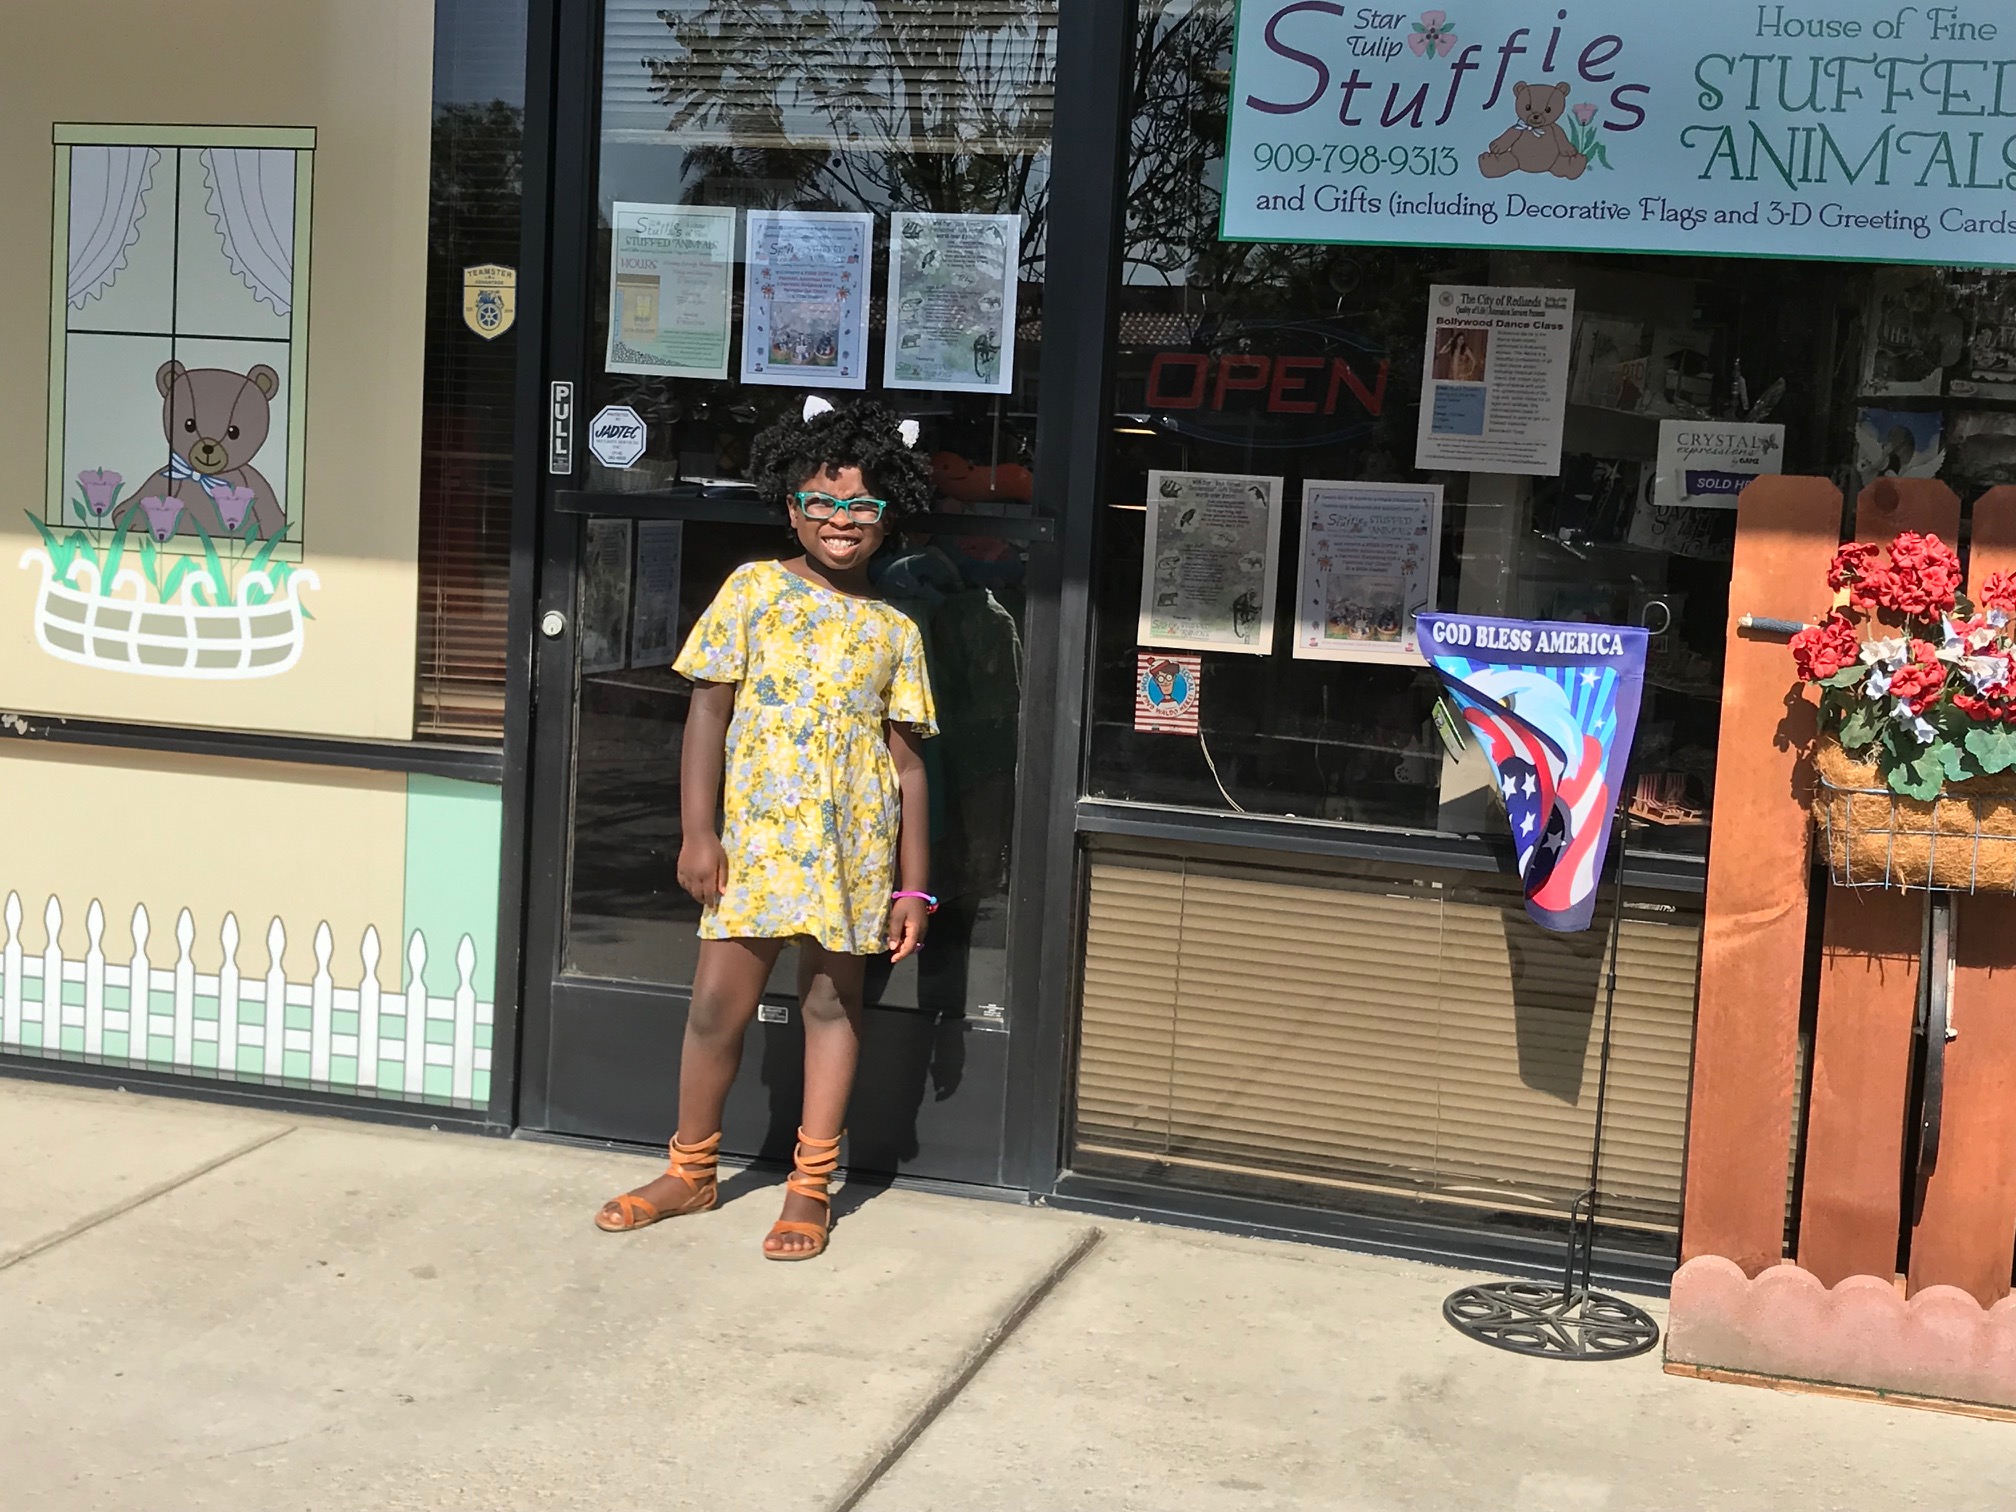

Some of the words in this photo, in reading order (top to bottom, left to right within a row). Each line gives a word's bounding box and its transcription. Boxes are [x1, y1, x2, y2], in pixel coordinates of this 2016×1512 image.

[1354, 8, 1407, 30] Star
[1755, 5, 1862, 38] House
[1872, 6, 1918, 39] of
[1926, 6, 1998, 41] Fine
[1346, 36, 1404, 62] Tulip
[1246, 0, 1651, 131] Stuffies
[1254, 143, 1459, 176] 909-798-9313
[1256, 185, 1305, 212] and
[1314, 184, 1382, 213] Gifts
[1388, 191, 1498, 225] (including
[1505, 193, 1631, 220] Decorative
[1638, 196, 1707, 231] Flags
[1714, 202, 1759, 225] and
[1766, 200, 1813, 227] 3-D
[1819, 202, 1931, 239] Greeting
[1939, 207, 2016, 235] Cards
[467, 268, 512, 278] TEAMSTER
[620, 258, 658, 270] HOURS
[1461, 293, 1475, 304] The
[1478, 294, 1494, 306] City
[1495, 295, 1505, 307] of
[1436, 317, 1492, 328] Bollywood
[1495, 319, 1530, 329] Dance
[1533, 321, 1564, 330] Class
[1146, 353, 1391, 416] OPEN
[554, 385, 569, 454] PULL
[595, 425, 640, 439] JADTEC
[1677, 432, 1760, 449] CRYSTAL
[1677, 446, 1755, 461] expressions
[1697, 478, 1732, 489] SOLD
[1432, 621, 1472, 646] GOD
[1475, 626, 1532, 652] BLESS
[1535, 631, 1624, 656] AMERICA
[1181, 668, 1194, 692] LOCAL
[1155, 707, 1178, 717] WALDO
